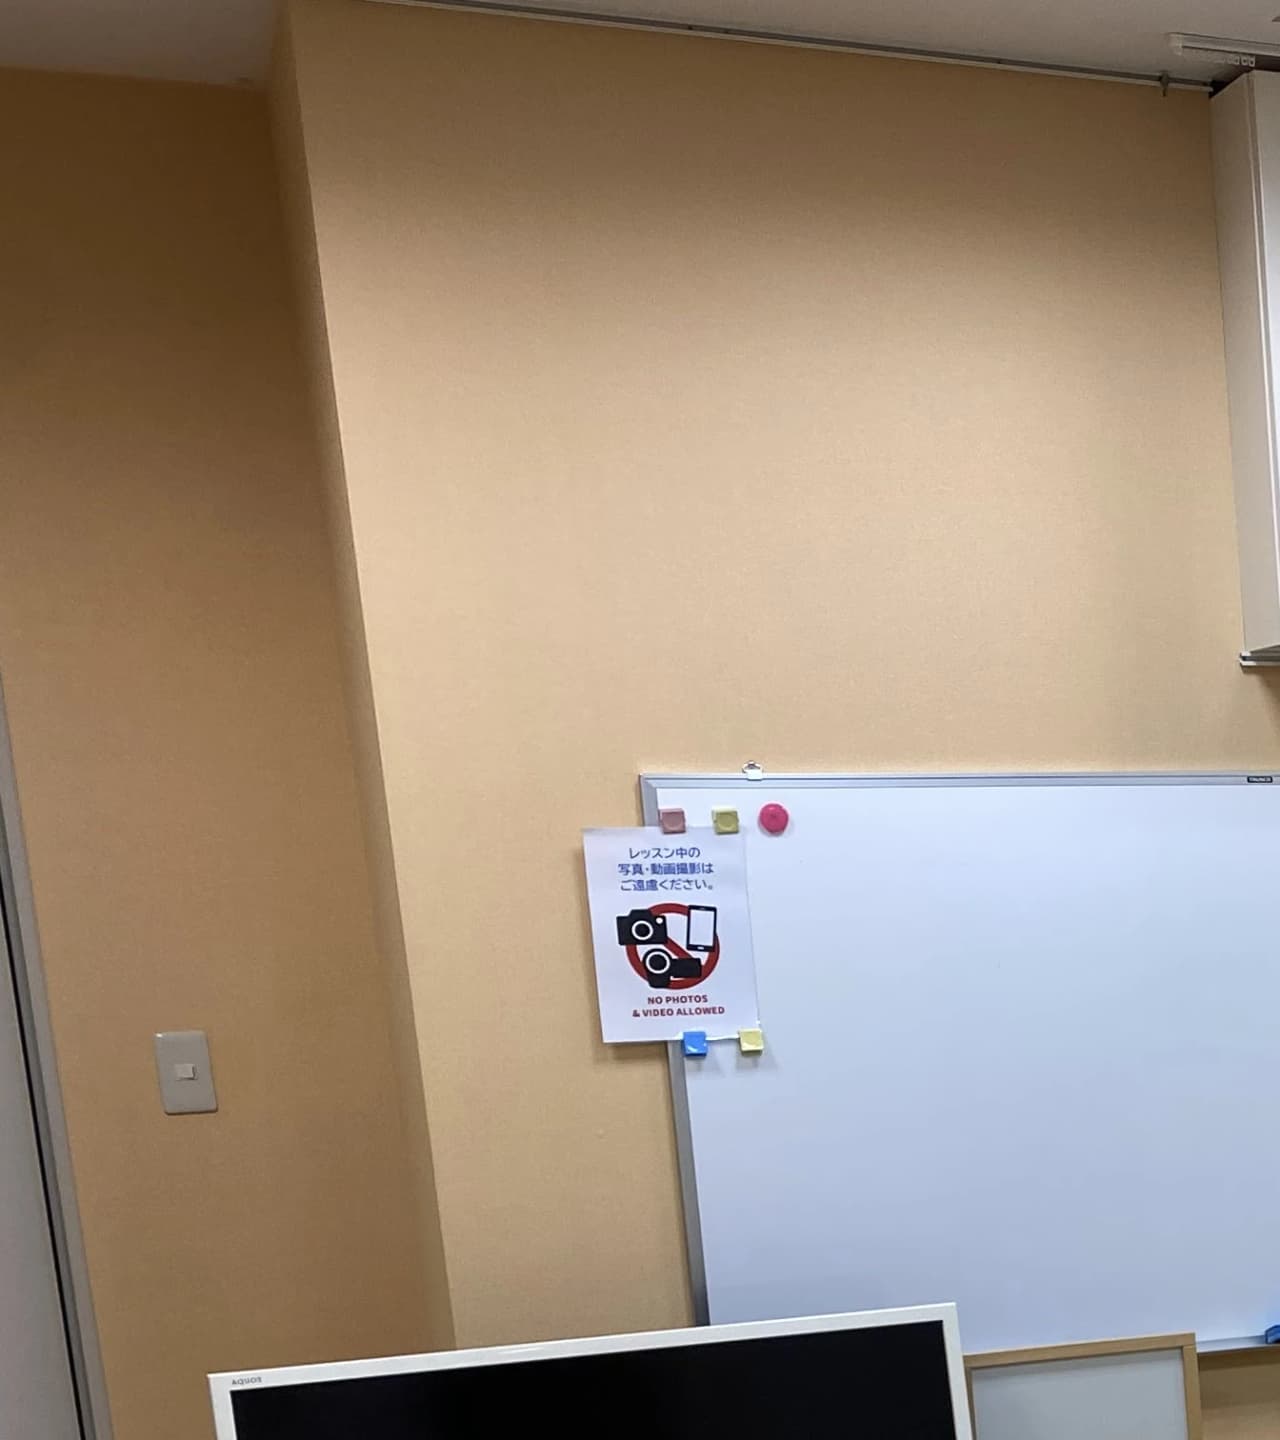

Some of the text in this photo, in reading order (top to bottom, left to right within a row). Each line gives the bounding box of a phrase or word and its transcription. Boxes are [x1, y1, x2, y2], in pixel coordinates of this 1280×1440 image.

[628, 847, 701, 859] レッスン中の
[617, 862, 714, 876] 写真・動画撮影は
[620, 879, 714, 892] ご遠慮ください。
[647, 995, 709, 1005] NO PHOTOS
[632, 1006, 726, 1018] & VIDEO ALLOWED
